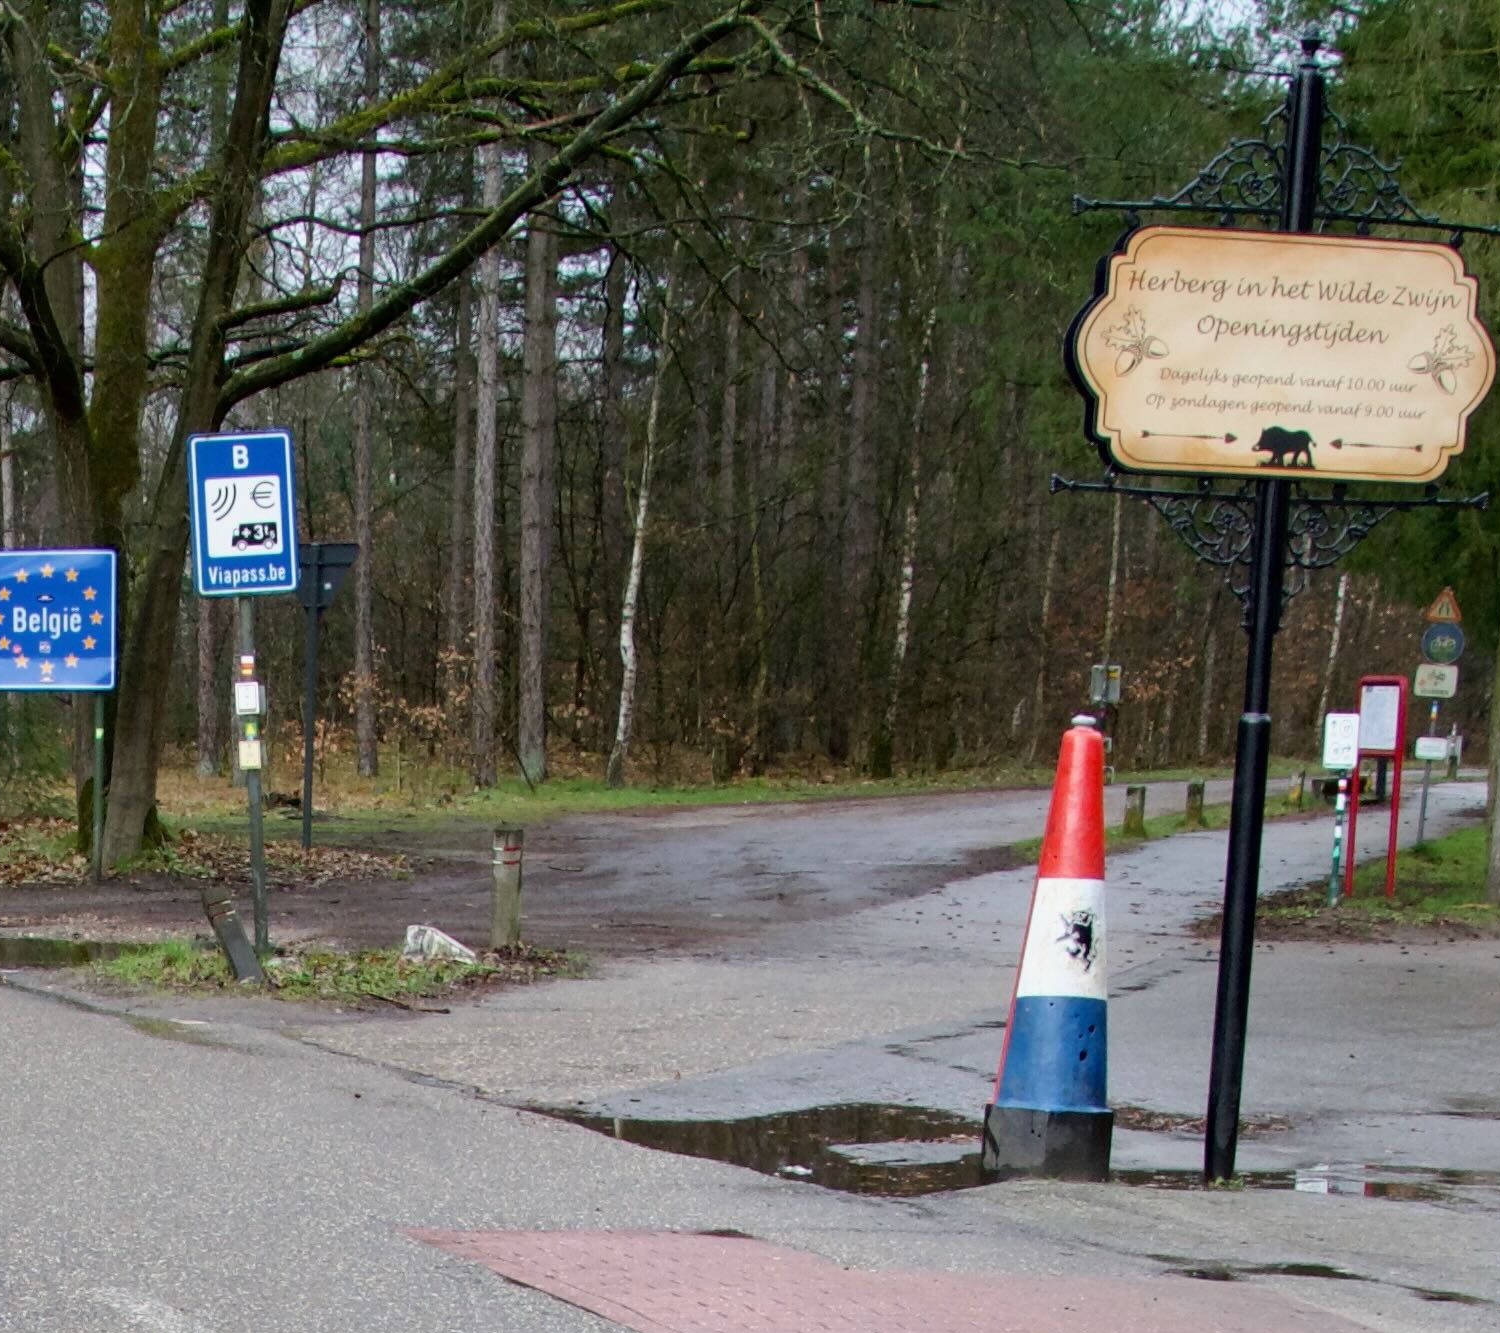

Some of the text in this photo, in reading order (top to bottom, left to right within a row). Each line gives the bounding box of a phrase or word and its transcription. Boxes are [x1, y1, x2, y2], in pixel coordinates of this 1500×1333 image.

[1128, 270, 1462, 315] Herberg in het Wilde Zwijn
[1196, 314, 1390, 349] Openingstijden
[1159, 367, 1418, 393] Dagelijks geopend vanaf 10.00 uur
[1145, 393, 1428, 420] Op zondagen geopend vanaf 9.00 uur
[231, 445, 249, 470] B
[208, 563, 287, 587] Viapass.be
[12, 606, 83, 640] België
